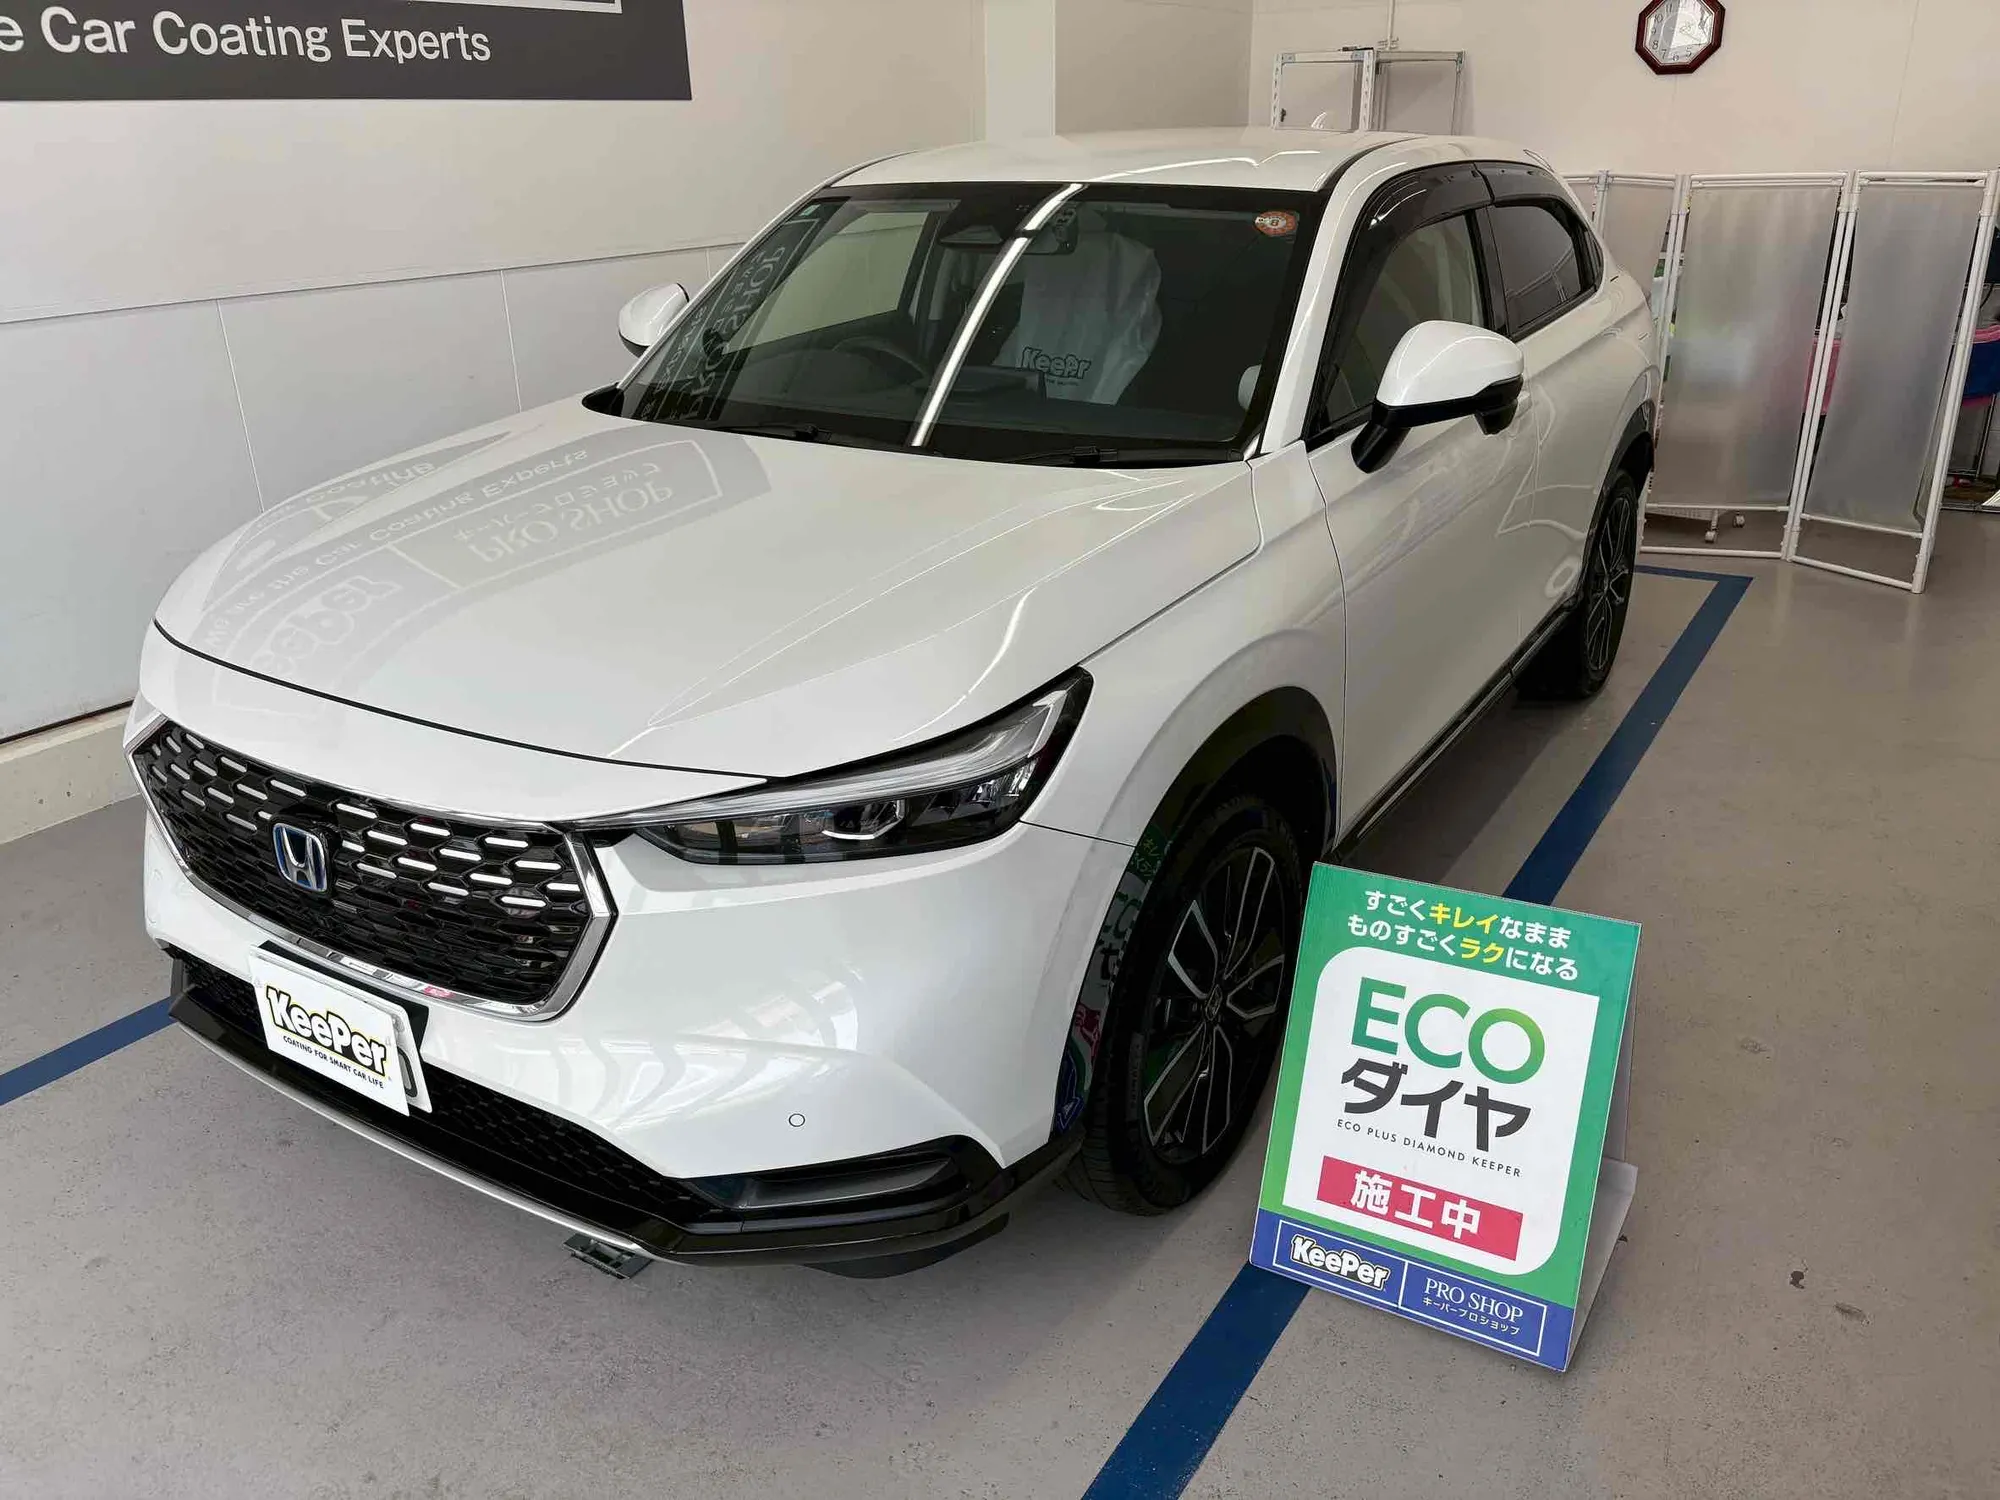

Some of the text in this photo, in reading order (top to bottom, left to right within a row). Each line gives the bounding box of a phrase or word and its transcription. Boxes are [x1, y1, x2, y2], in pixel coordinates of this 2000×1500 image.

[40, 6, 136, 53] Car
[152, 10, 331, 62] Coating
[341, 18, 491, 64] Experts
[1347, 913, 1579, 982] ものすごくラクになる
[1365, 889, 1572, 950] すごくキレイなまま
[265, 984, 388, 1078] KeePer
[1351, 976, 1546, 1085] ECO
[283, 1034, 385, 1089] COATING FOR SMART CAR LIFE
[1341, 1058, 1532, 1152] ダイヤ
[1337, 1118, 1522, 1178] ECO PLUS DIAMOND KEEPER
[1350, 1169, 1482, 1240] 施工中
[1290, 1233, 1392, 1292] KeePer
[1422, 1296, 1521, 1336] キーパープロショップ
[1423, 1276, 1524, 1324] PRO SHOP
